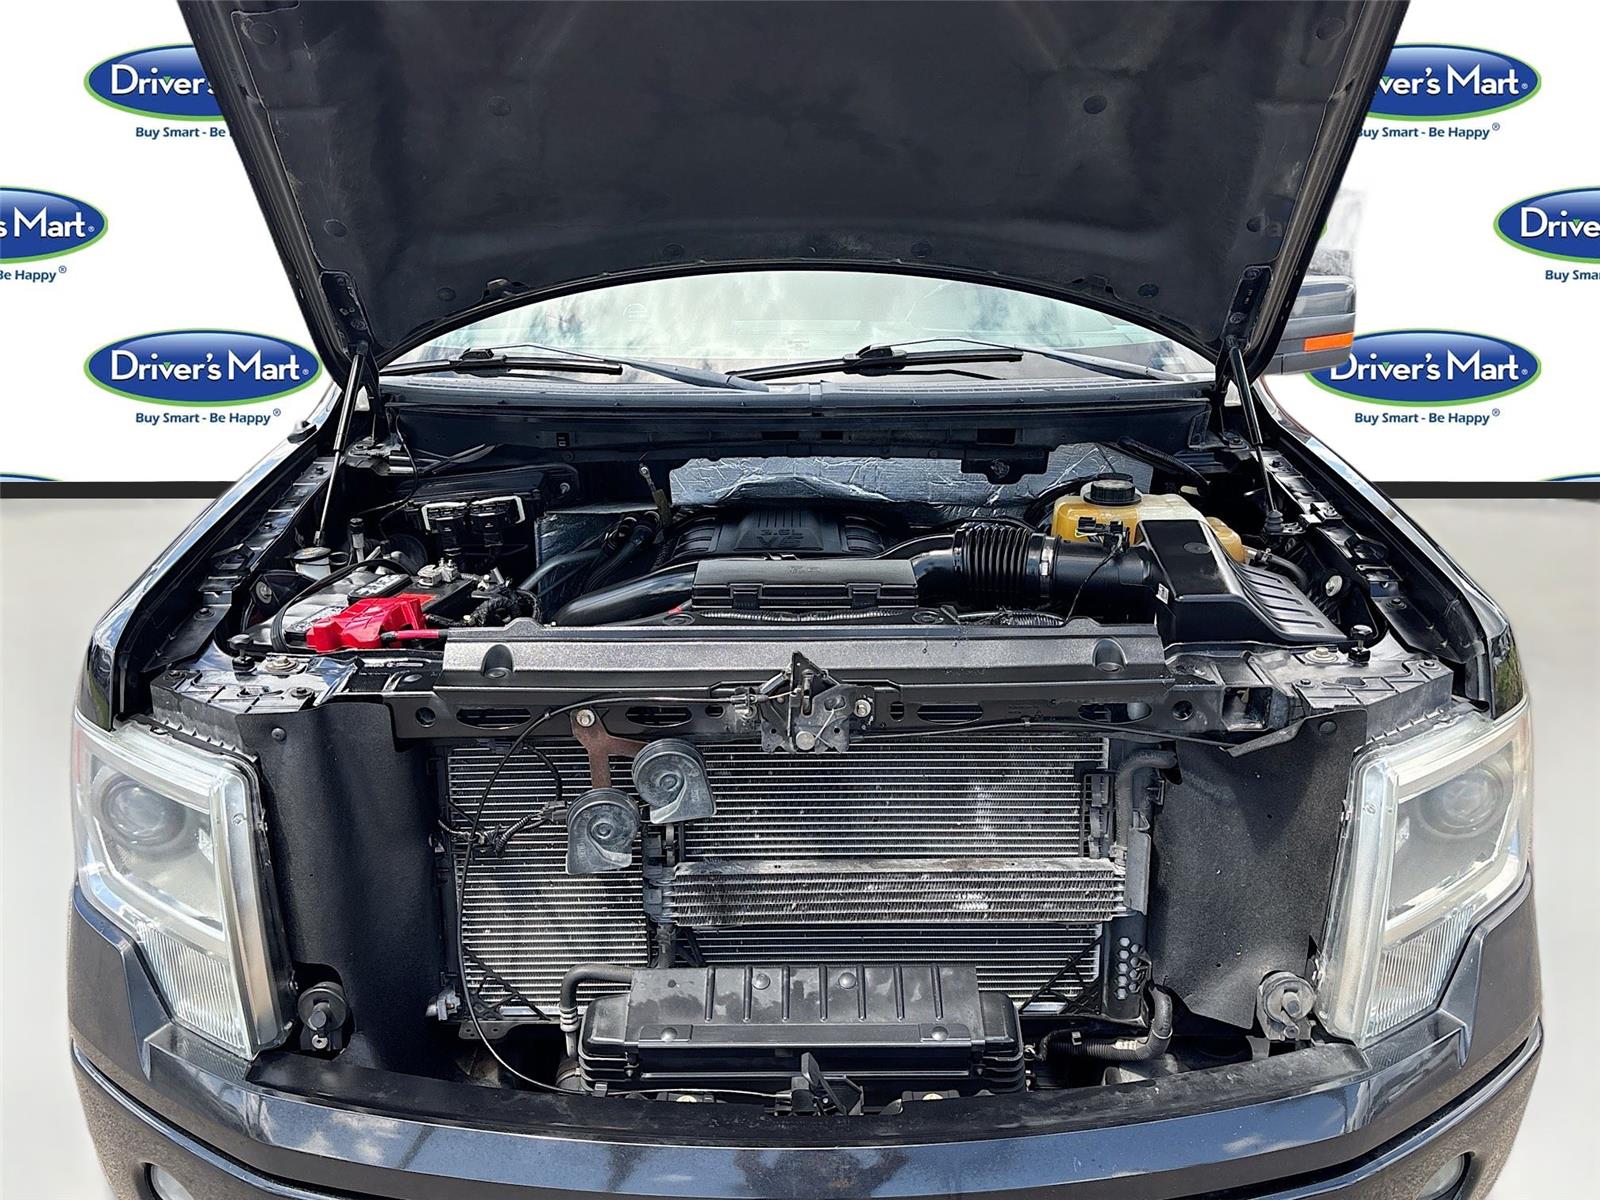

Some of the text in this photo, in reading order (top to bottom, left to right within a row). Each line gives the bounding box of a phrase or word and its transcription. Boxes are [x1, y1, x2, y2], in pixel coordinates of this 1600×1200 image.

[111, 64, 216, 95] Driver
[1380, 64, 1519, 95] ver's Mart
[135, 127, 161, 140] Buy
[162, 127, 200, 138] Smart
[209, 127, 227, 138] Be
[1381, 127, 1419, 138] Smart
[1428, 127, 1446, 138] Be
[1448, 127, 1490, 140] Happy
[14, 206, 86, 238] Mart
[14, 270, 57, 283] Happy
[1544, 270, 1600, 283] Buy Sma
[111, 350, 300, 381] Driver's Mart
[1331, 350, 1519, 381] Driver's Mart
[135, 412, 161, 426] Buy
[162, 412, 200, 424] Smart
[209, 412, 227, 424] Be
[229, 412, 271, 426] Happy
[1354, 412, 1380, 426] Buy
[1381, 412, 1419, 424] Smart
[1428, 412, 1446, 424] Be
[1448, 412, 1490, 426] Happy
